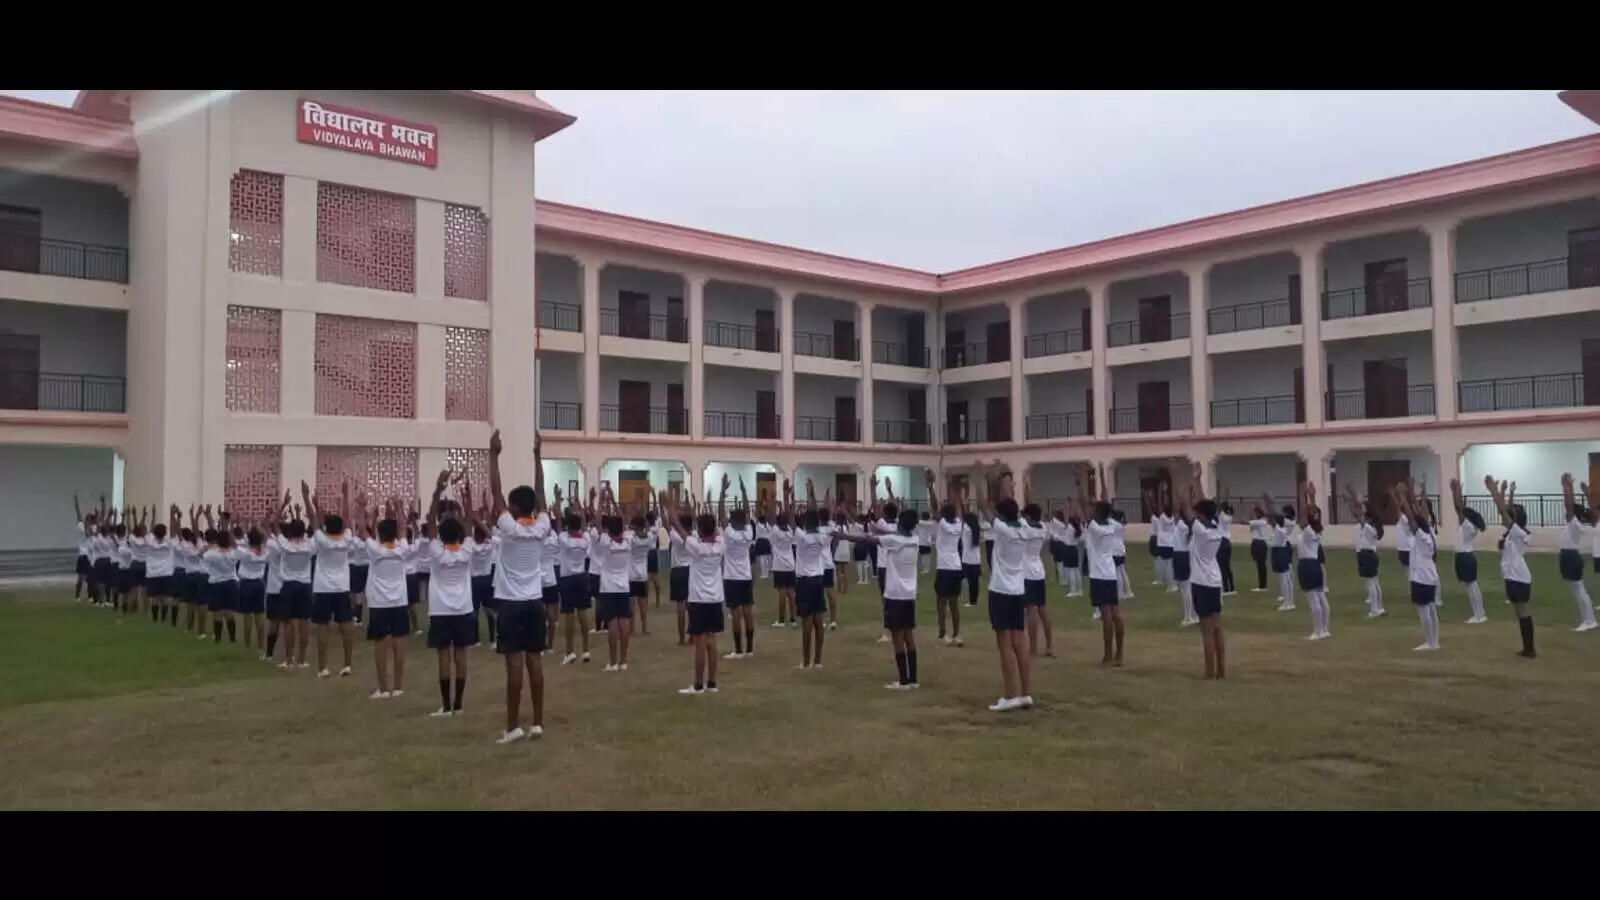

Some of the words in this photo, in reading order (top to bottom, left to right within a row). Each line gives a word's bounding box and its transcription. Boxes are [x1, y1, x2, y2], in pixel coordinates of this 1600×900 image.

[303, 101, 385, 138] विद्यालय
[392, 124, 435, 149] भवन
[313, 129, 373, 151] VIDYALAYA
[380, 143, 425, 162] BHAWAN
